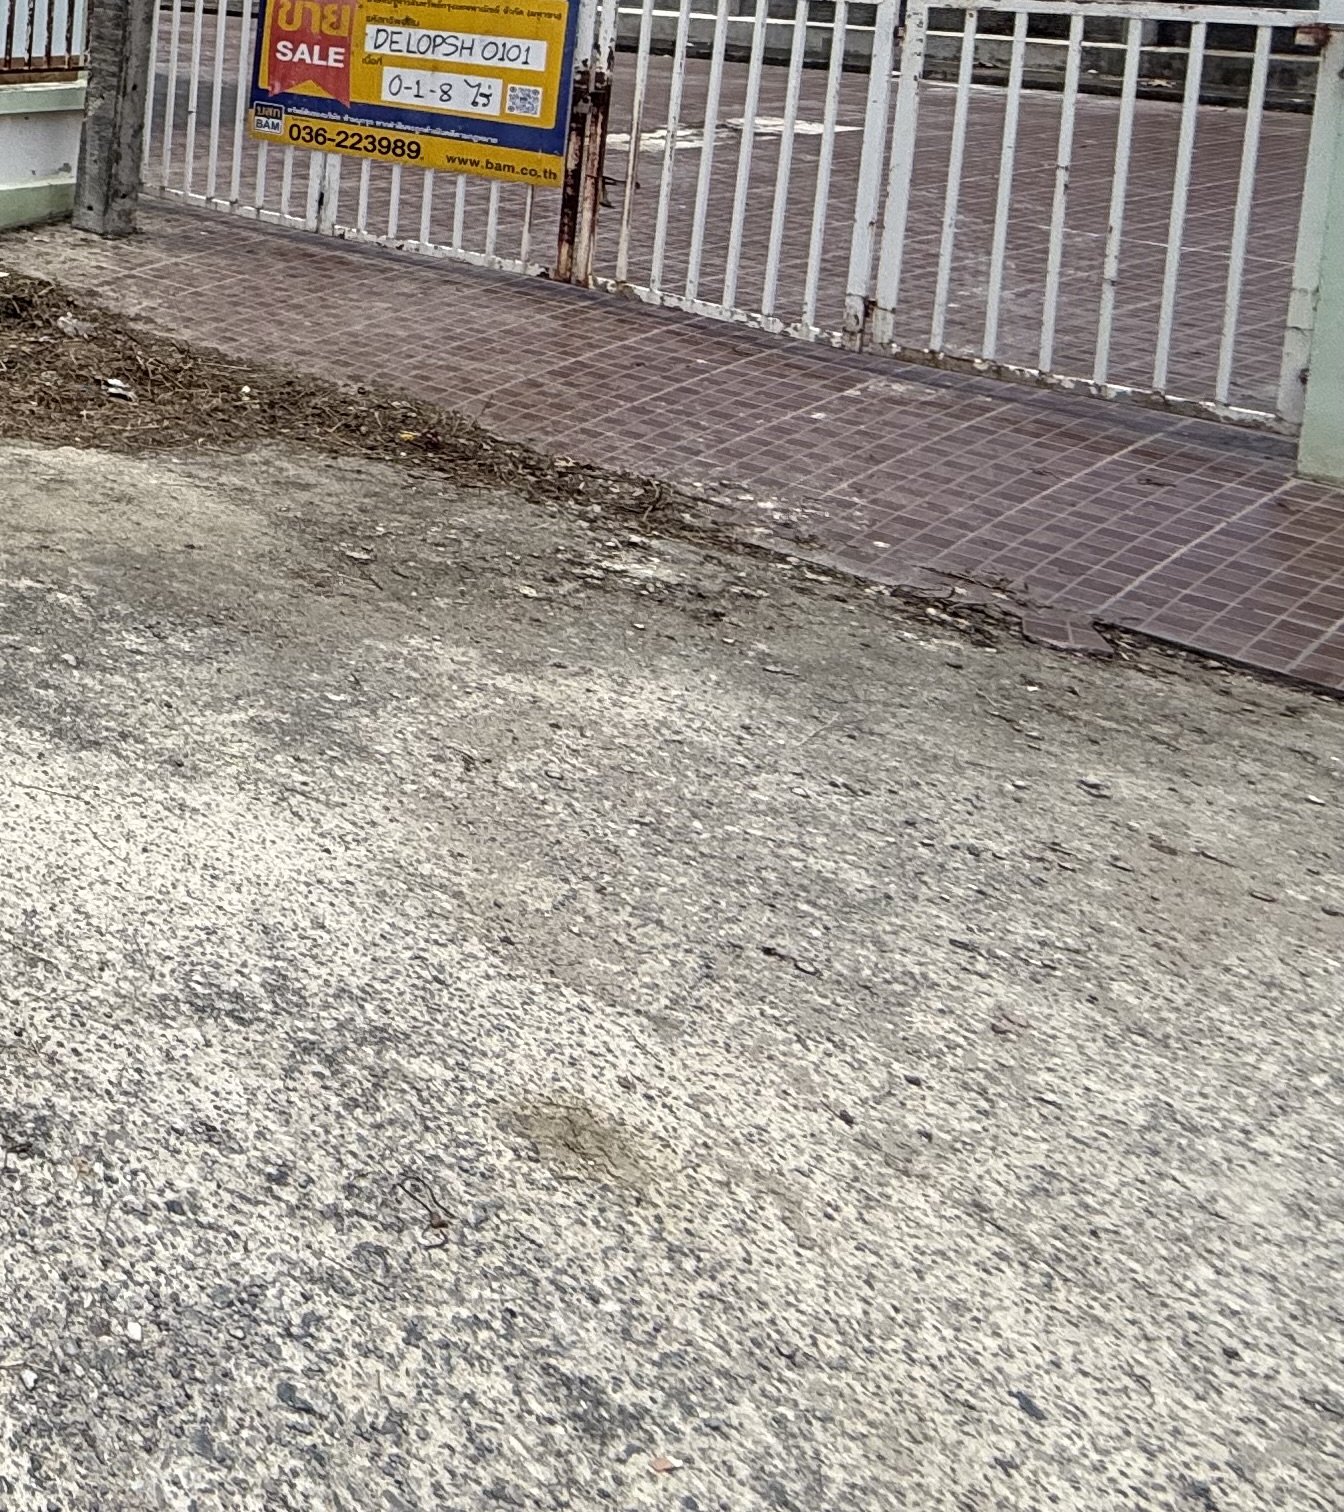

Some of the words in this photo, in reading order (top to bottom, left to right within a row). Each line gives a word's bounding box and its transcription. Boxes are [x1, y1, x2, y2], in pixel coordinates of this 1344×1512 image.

[275, 40, 346, 68] SALE
[481, 41, 531, 65] 0101
[388, 74, 453, 102] 0-1-8
[255, 118, 280, 131] BAM
[289, 123, 421, 159] 036-223989
[445, 154, 558, 180] www.bam.co.th
